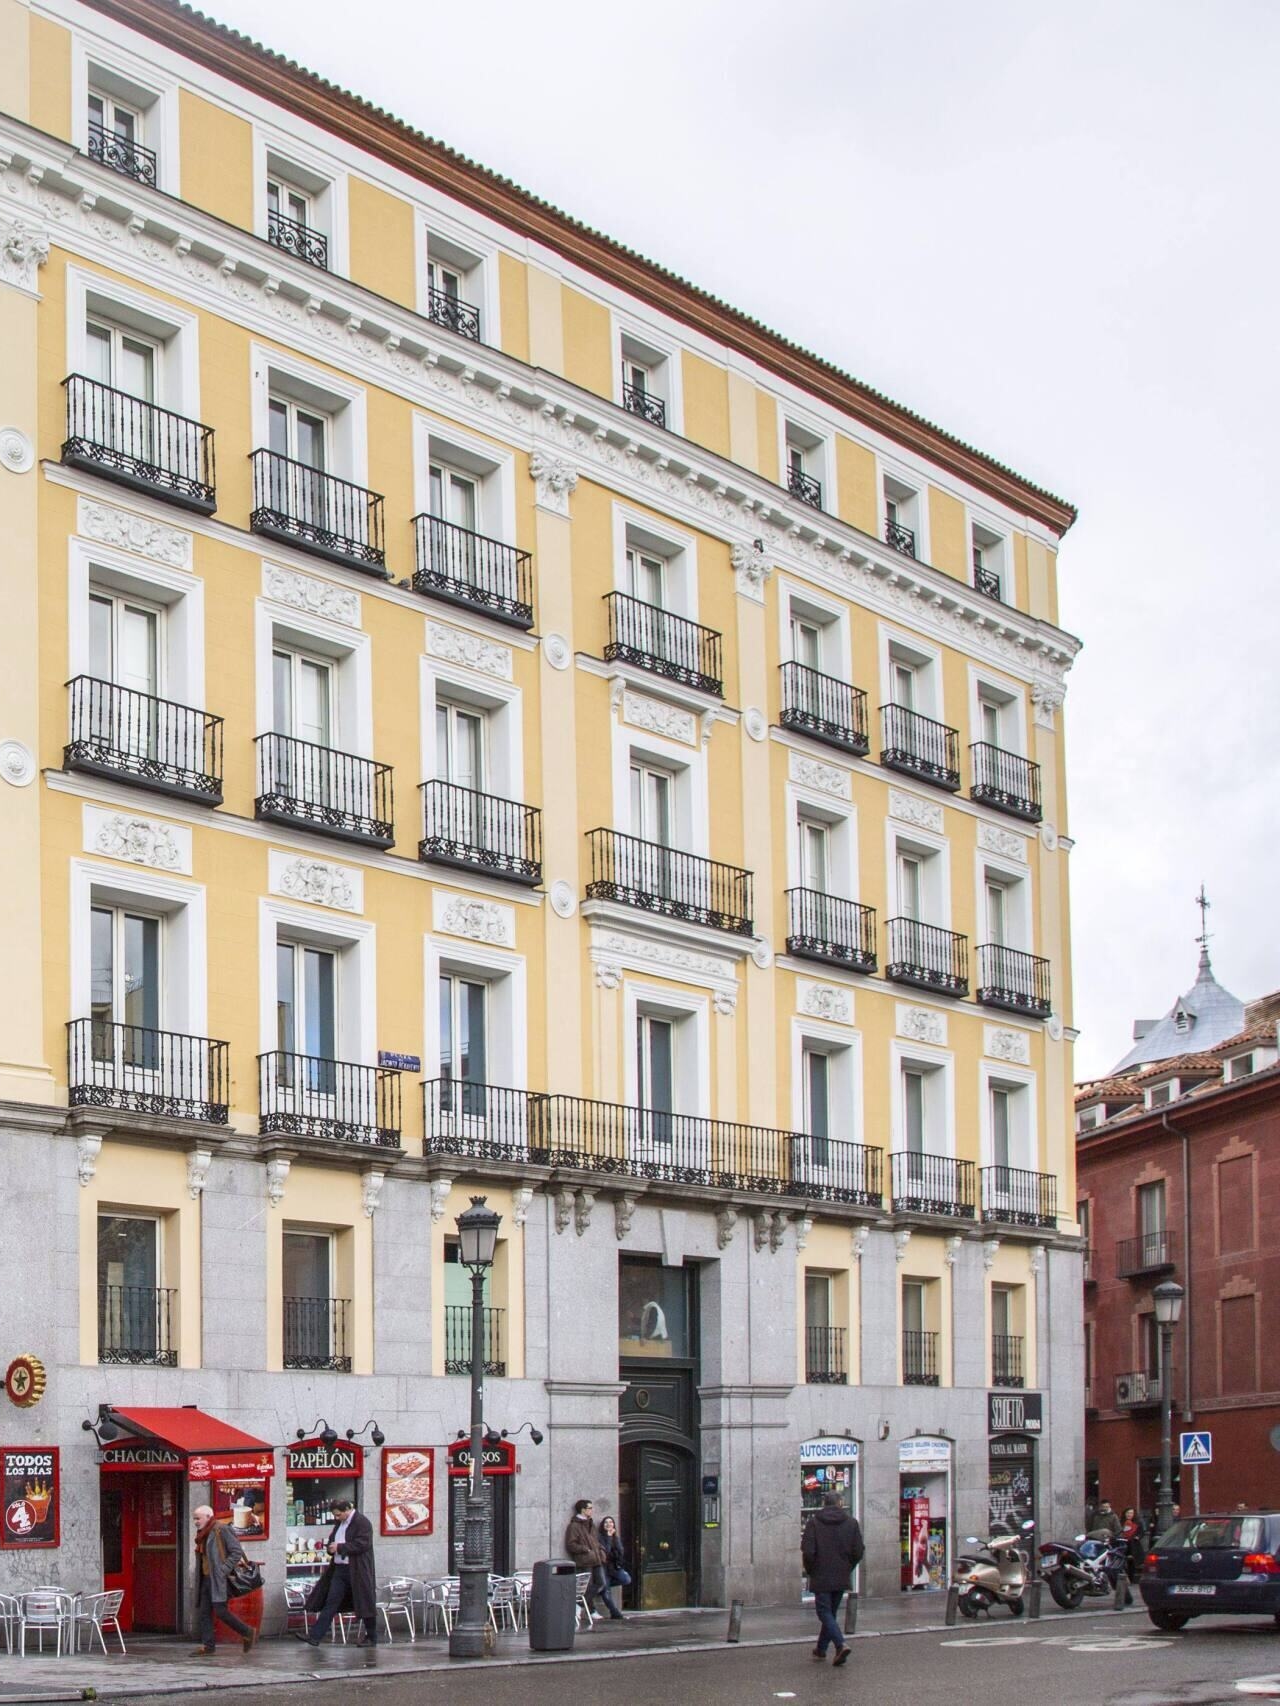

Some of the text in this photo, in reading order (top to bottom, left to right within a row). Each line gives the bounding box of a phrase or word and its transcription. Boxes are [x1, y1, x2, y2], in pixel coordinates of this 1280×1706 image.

[103, 1450, 180, 1463] CHACINAS
[800, 1443, 858, 1457] AUTOSERVICIO
[5, 1455, 53, 1467] TODOS
[289, 1448, 355, 1469] PAPELÓN
[458, 1451, 501, 1465] QSOS
[5, 1466, 53, 1476] LOS DÍAS
